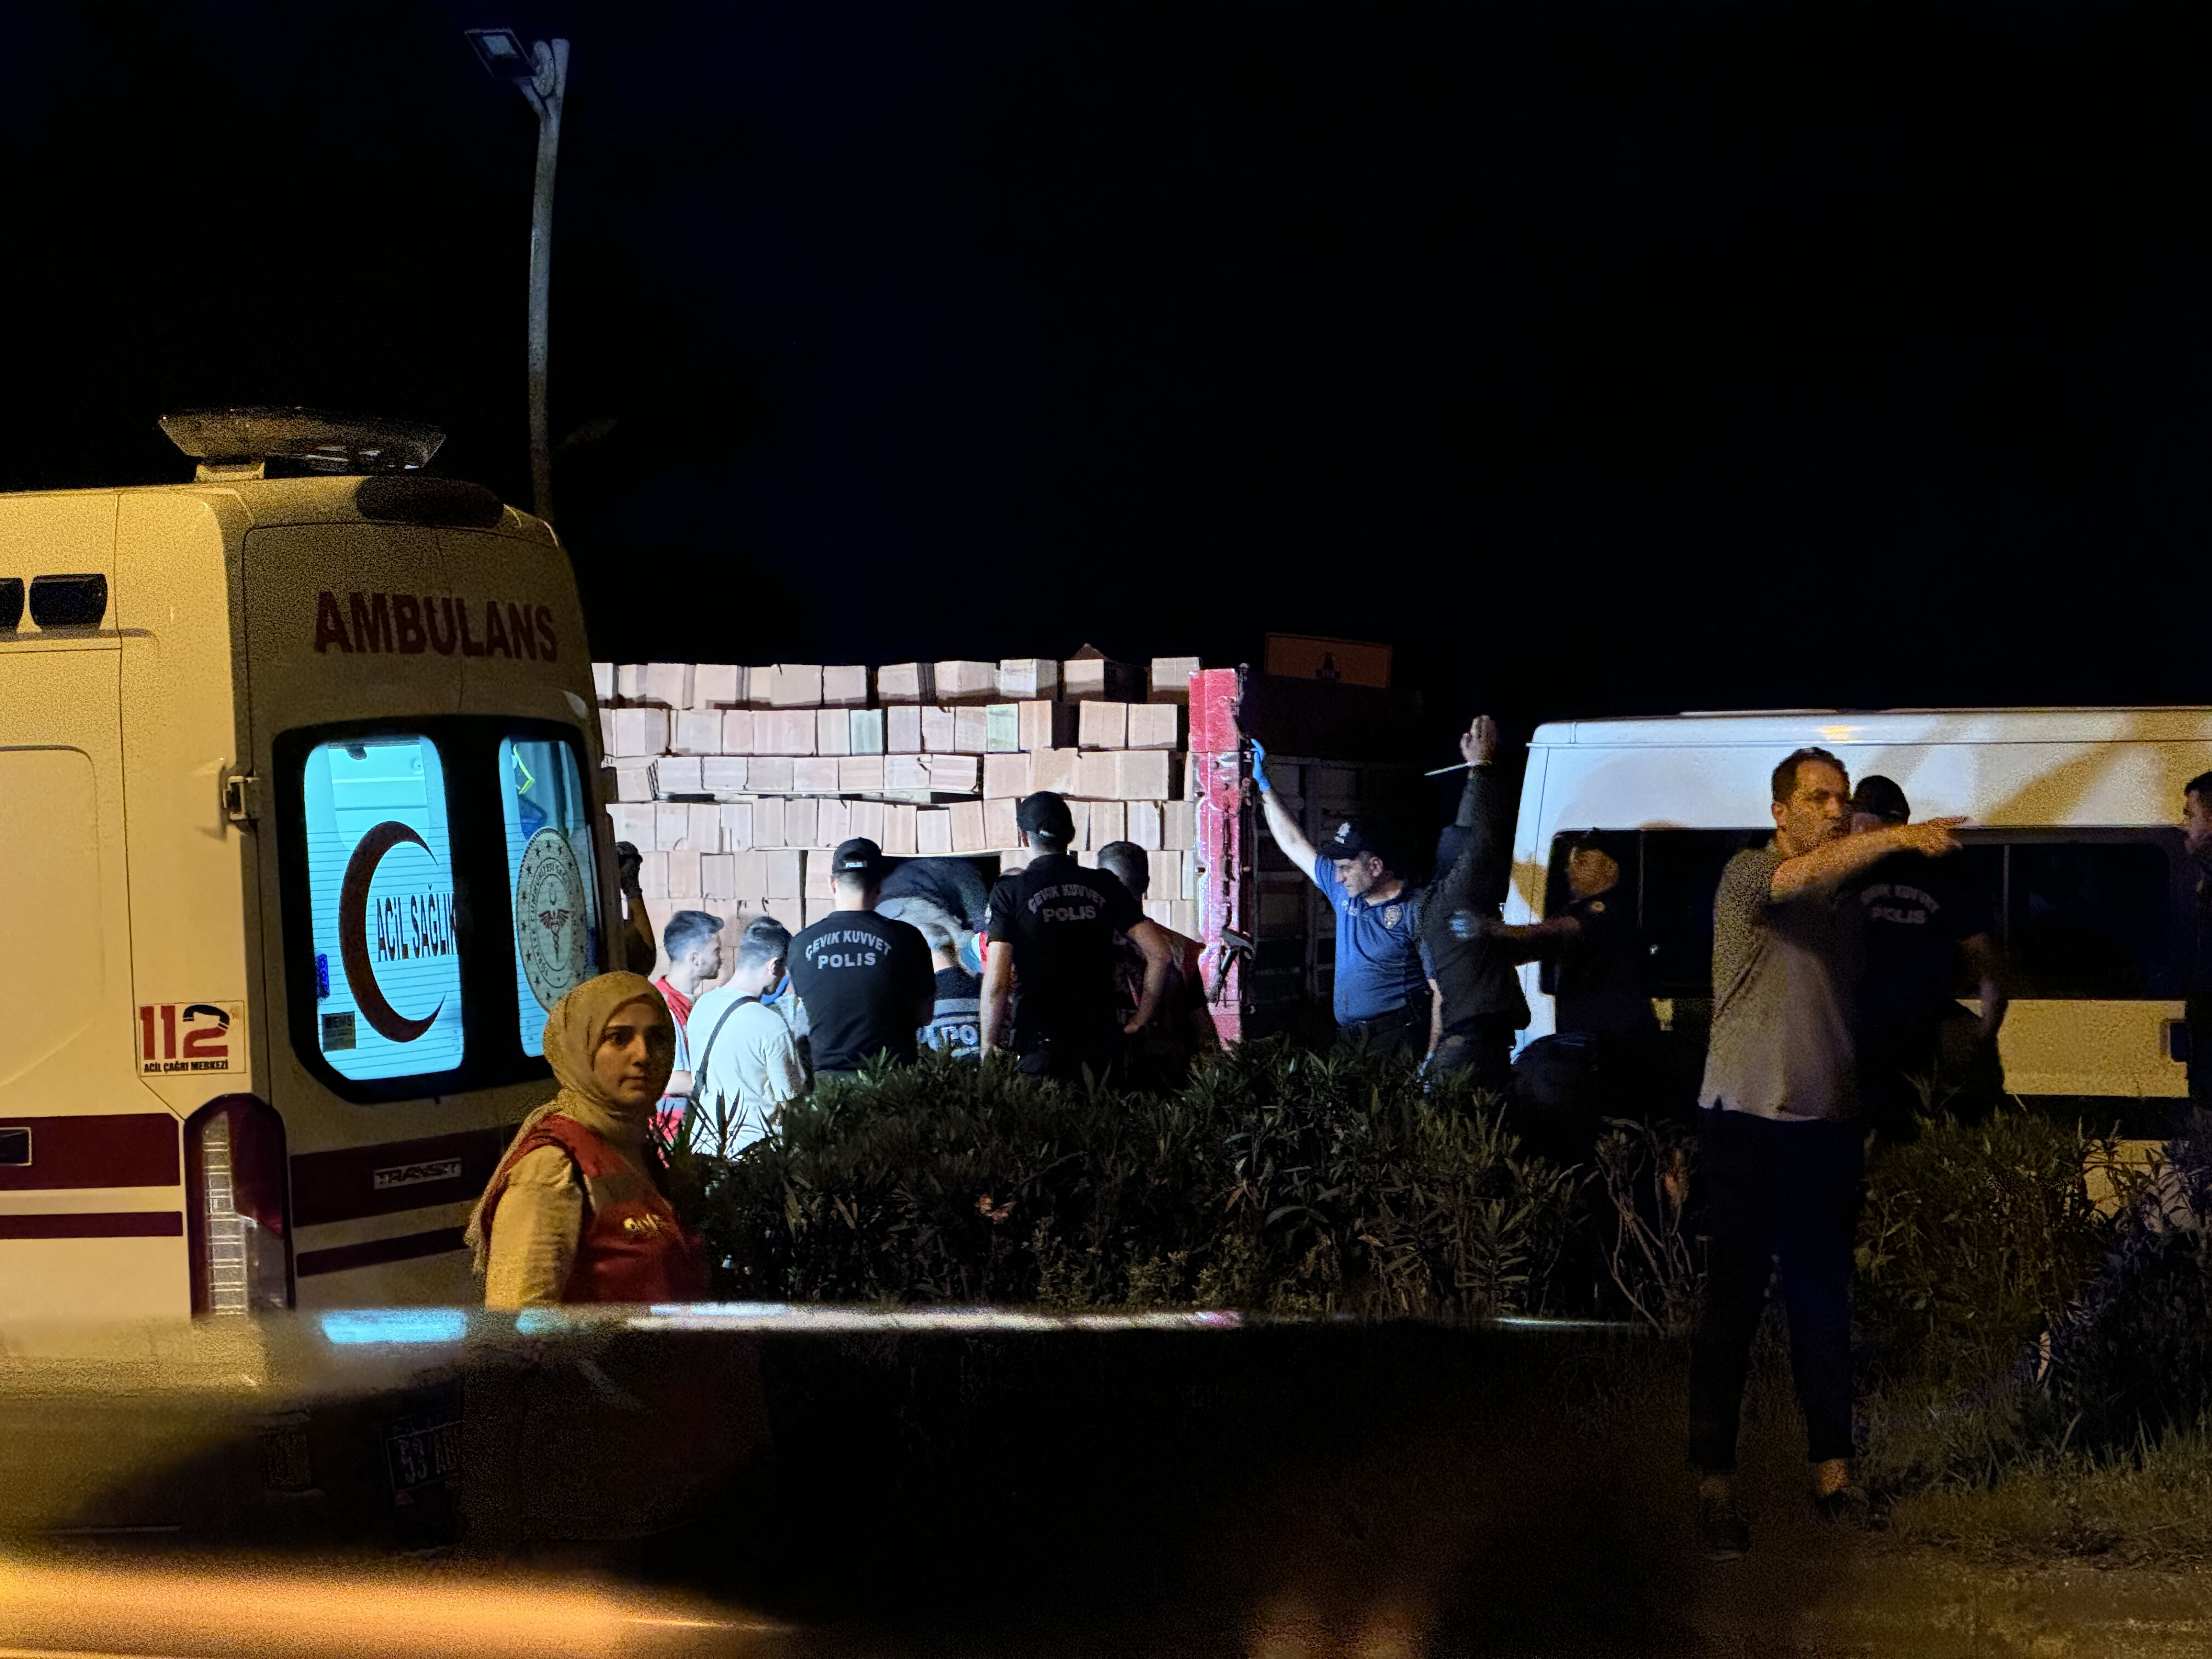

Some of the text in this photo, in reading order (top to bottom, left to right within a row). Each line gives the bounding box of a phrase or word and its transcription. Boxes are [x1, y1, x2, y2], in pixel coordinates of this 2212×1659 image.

[314, 591, 557, 662] AMBULANS
[377, 896, 409, 962] ACİL
[843, 930, 893, 956] KUVVET
[140, 1005, 230, 1060] 112
[144, 1062, 162, 1073] ACİL
[190, 1059, 228, 1071] MERKEZİ
